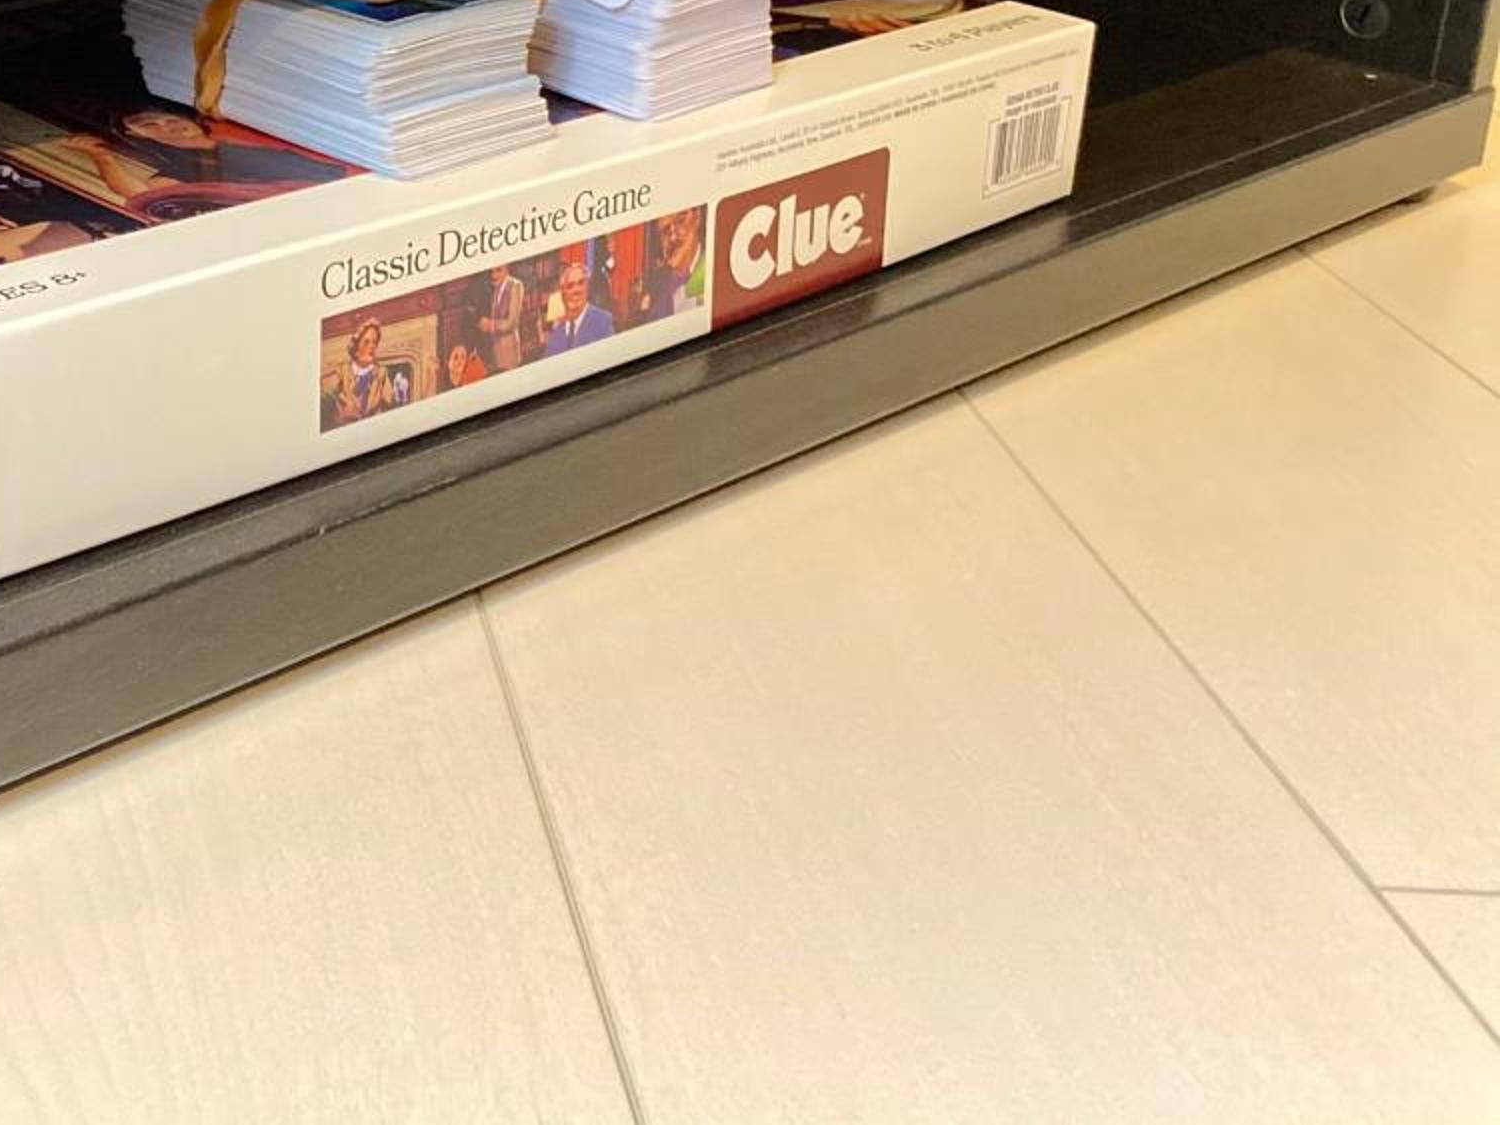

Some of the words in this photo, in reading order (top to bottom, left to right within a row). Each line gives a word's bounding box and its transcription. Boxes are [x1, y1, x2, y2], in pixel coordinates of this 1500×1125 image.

[54, 269, 87, 290] 8+
[321, 242, 431, 301] Classic
[437, 205, 568, 268] Detective
[574, 181, 652, 227] Game
[729, 193, 865, 291] Clue
